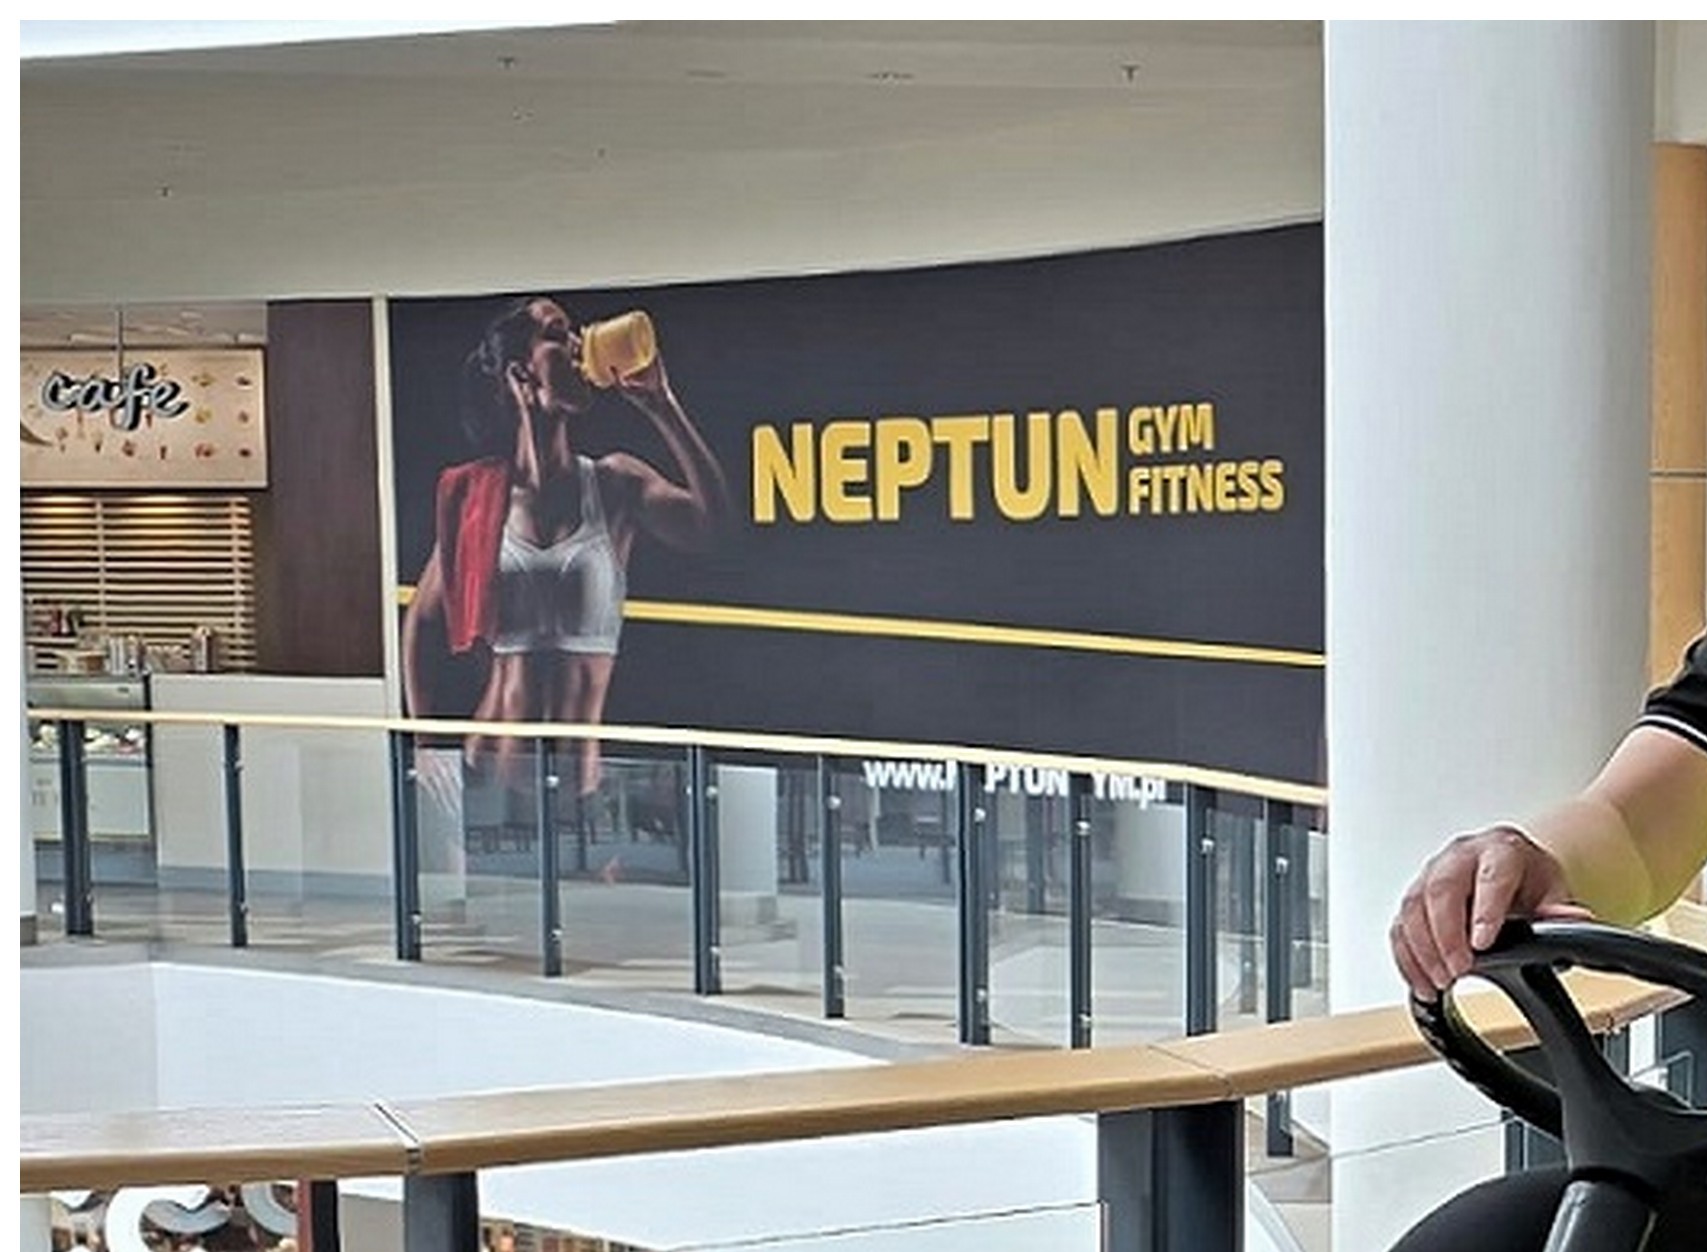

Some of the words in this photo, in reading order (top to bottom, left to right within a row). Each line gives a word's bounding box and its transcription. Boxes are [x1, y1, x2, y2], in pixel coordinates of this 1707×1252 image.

[42, 362, 189, 431] cafe
[1128, 403, 1213, 454] GYM
[753, 407, 1119, 523] NEPTUN
[1128, 460, 1285, 515] FITNESS
